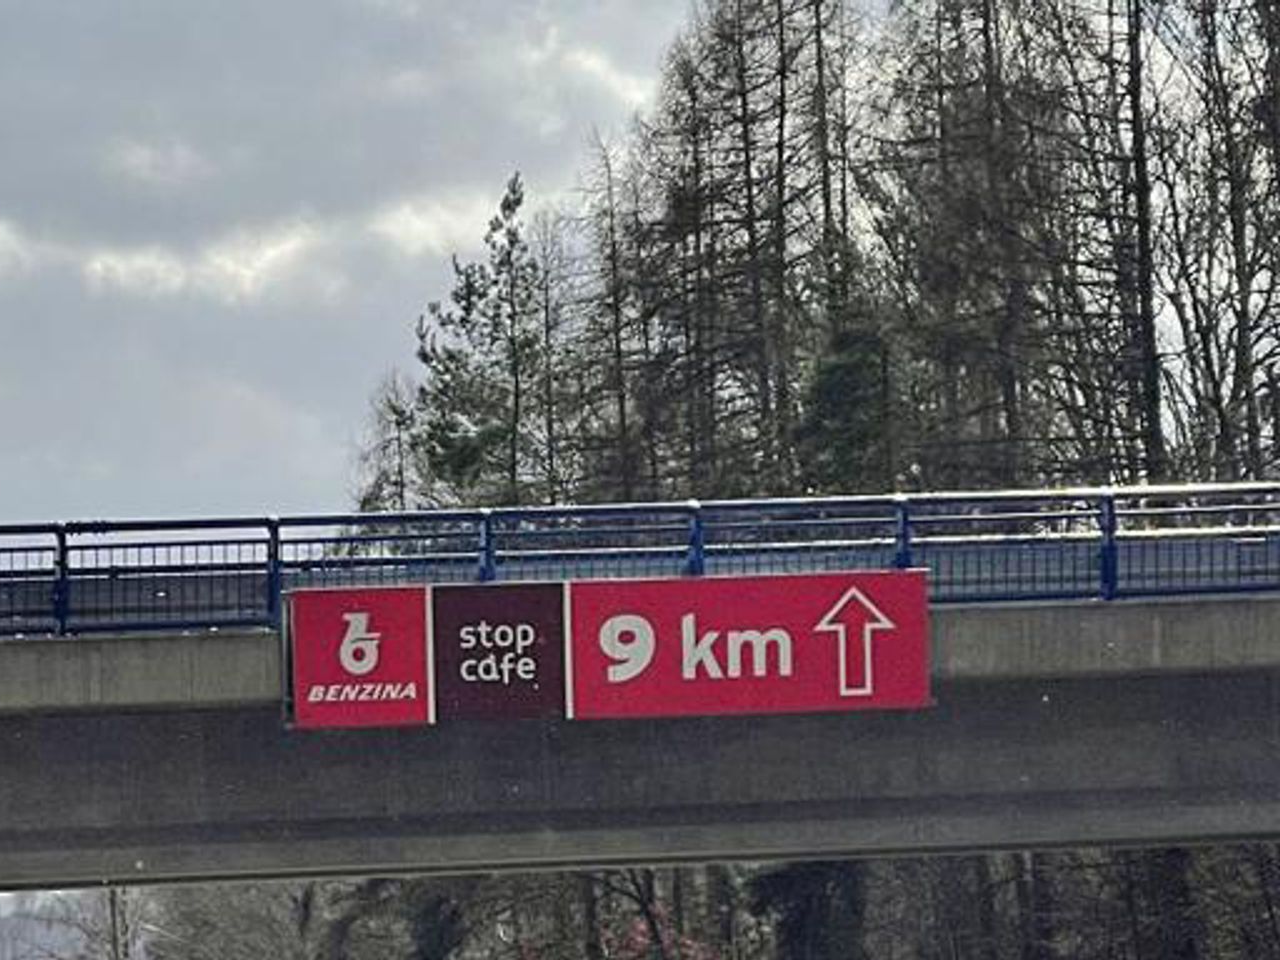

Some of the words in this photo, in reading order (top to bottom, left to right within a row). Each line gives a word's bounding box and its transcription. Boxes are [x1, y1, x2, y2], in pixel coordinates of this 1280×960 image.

[460, 620, 535, 654] stop
[599, 614, 656, 683] 9
[681, 612, 792, 679] km
[308, 682, 417, 702] BENZINA
